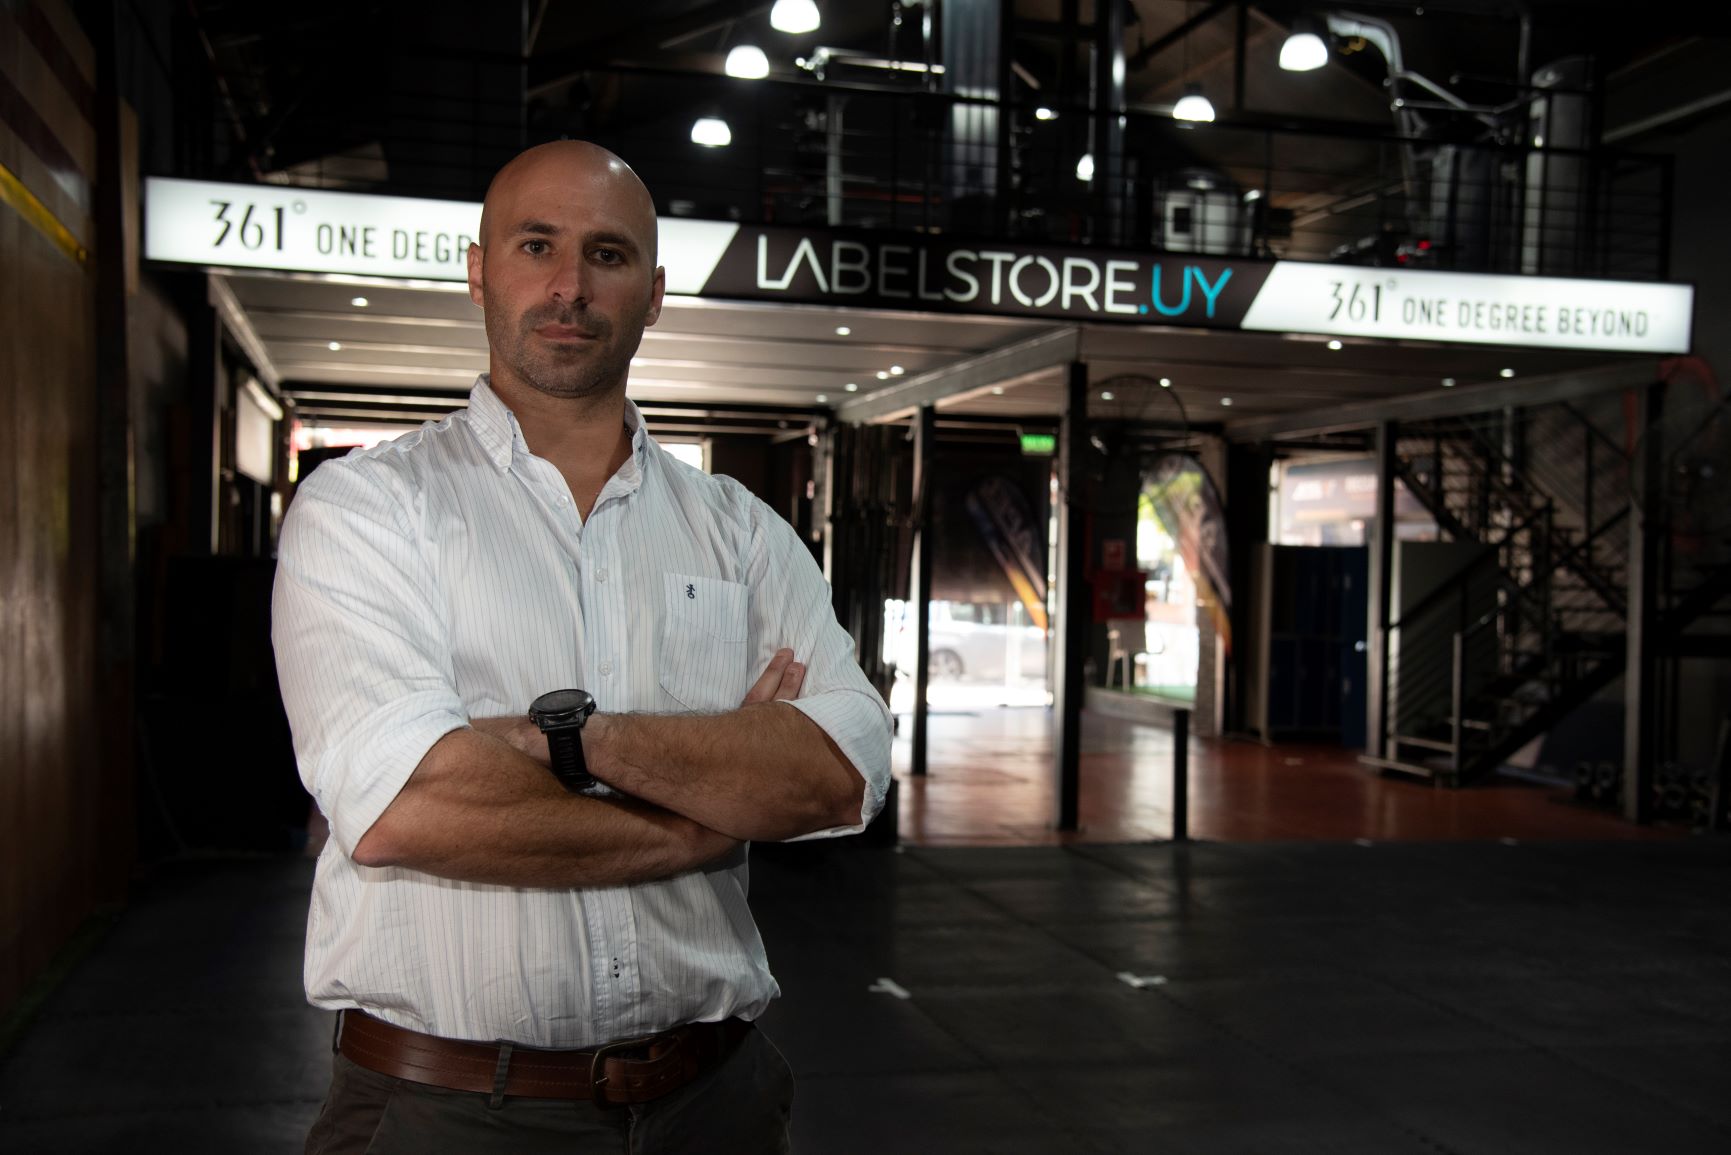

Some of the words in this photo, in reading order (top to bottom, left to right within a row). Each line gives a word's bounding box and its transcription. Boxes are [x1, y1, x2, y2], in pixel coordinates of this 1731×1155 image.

[316, 223, 376, 259] ONE
[757, 234, 1233, 317] LABELSTORE.UY
[1403, 297, 1447, 327] ONE
[1458, 301, 1548, 334] DEGREE
[1557, 307, 1649, 337] BEYOND
